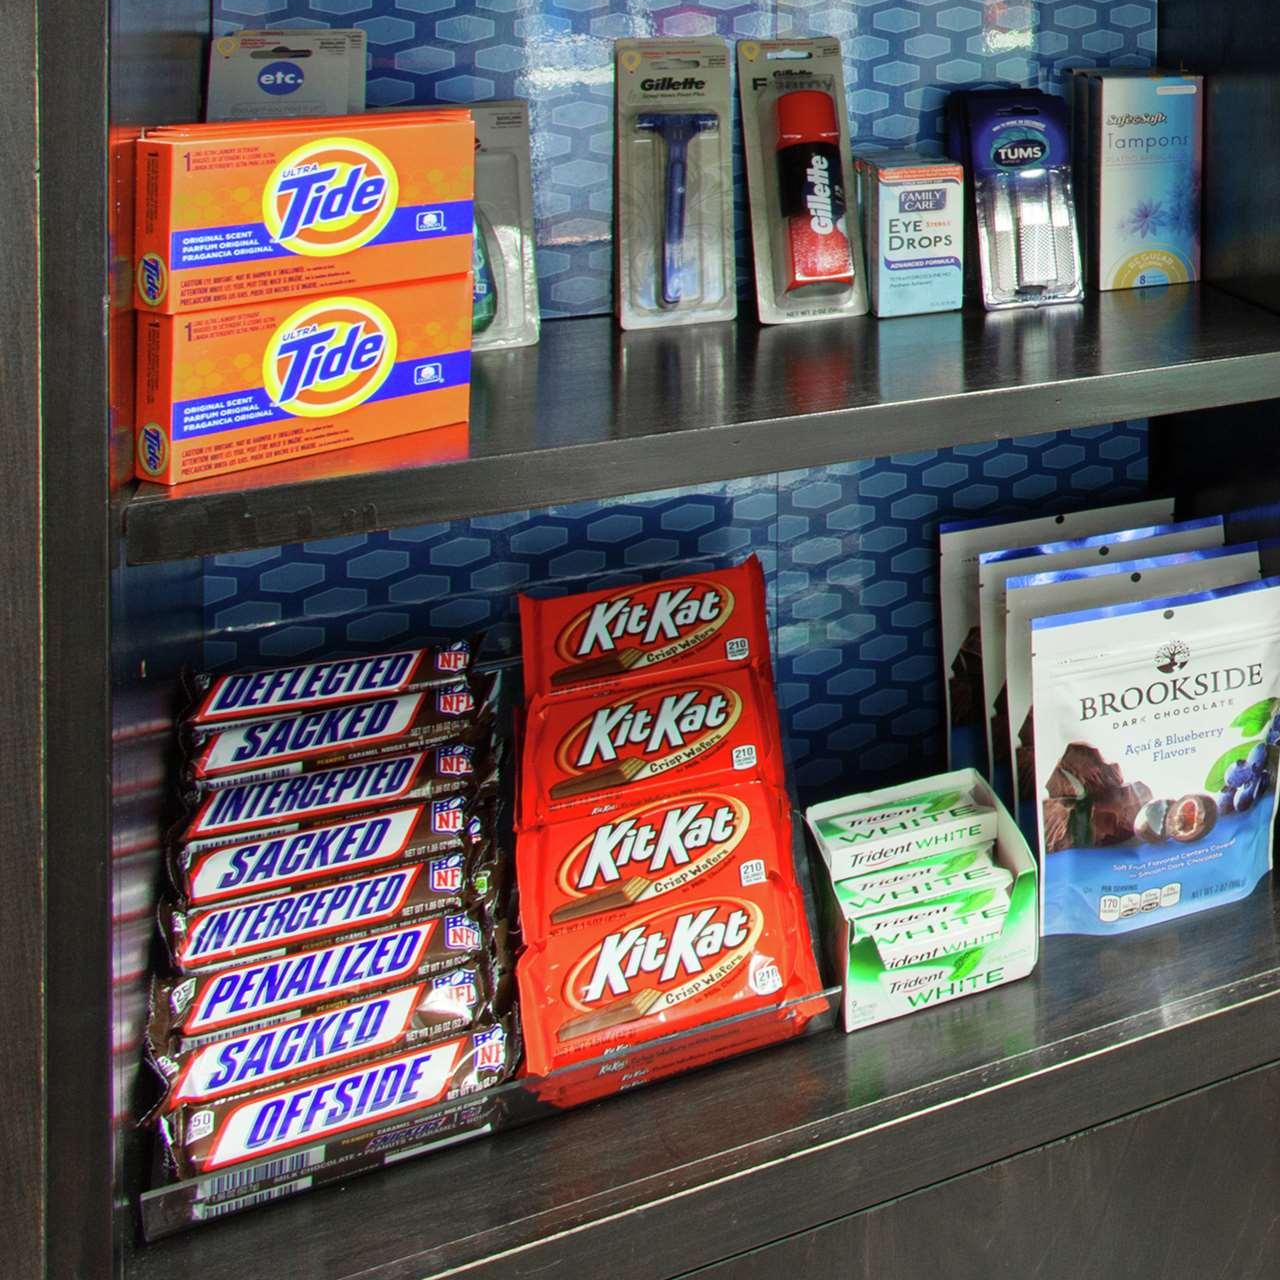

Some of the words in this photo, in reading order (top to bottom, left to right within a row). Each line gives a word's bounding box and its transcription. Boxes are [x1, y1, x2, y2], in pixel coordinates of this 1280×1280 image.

[260, 72, 304, 84] etc.
[640, 77, 705, 92] Gillette
[998, 147, 1042, 160] TUMS
[1107, 132, 1189, 153] Tampons
[282, 163, 318, 178] ULTRA
[276, 163, 389, 242] Tide
[807, 153, 833, 236] Gillette
[901, 191, 940, 202] FAMILY
[905, 200, 937, 211] CARE
[182, 234, 223, 245] ORIGINAL
[225, 231, 252, 241] SCENT
[182, 242, 217, 253] PARFUM
[219, 239, 259, 250] ORIGINAL
[182, 250, 232, 261] FRAGANCIA
[233, 246, 273, 256] ORIGINAL
[890, 261, 925, 269] ADVANCED
[925, 258, 955, 267] FORMULA
[282, 325, 317, 342] ULTRA
[276, 321, 386, 406] Tide
[184, 401, 223, 415] ORIGINAL
[226, 397, 253, 408] SCENT
[184, 410, 218, 424] PARFUM
[220, 404, 259, 417] ORIGINAL
[184, 418, 233, 432] FRAGANCIA
[234, 410, 273, 423] ORIGINAL
[646, 646, 679, 663] Crisp
[679, 627, 716, 650] Wafers
[729, 640, 746, 651] 210
[213, 653, 414, 711] DEFLECTED
[1080, 663, 1263, 721] BROOKSIDE
[441, 693, 474, 713] NFL
[1154, 698, 1235, 720] CHOCOLATE
[231, 699, 398, 762] SACKED
[1154, 737, 1163, 746] &
[1165, 727, 1224, 746] Blueberry
[649, 755, 682, 773] Crisp
[683, 733, 722, 759] Wafers
[735, 747, 753, 758] 210
[1152, 746, 1196, 762] Flavors
[206, 757, 415, 826] INTERCEPTED
[840, 804, 979, 843] WHITE
[848, 806, 918, 827] Trident
[217, 818, 392, 890] SACKED
[851, 842, 913, 868] Trident
[915, 824, 982, 849] WHITE
[654, 873, 689, 893] Crisp
[689, 849, 729, 874] Wafers
[743, 863, 762, 875] 210
[860, 867, 934, 890] Trident
[850, 867, 992, 908] WHITE
[191, 873, 408, 956] INTERCEPTED
[1103, 899, 1118, 909] 170
[875, 906, 948, 930] Trident
[200, 930, 423, 1021] PENALIZED
[665, 983, 701, 1005] Crisp
[703, 954, 744, 983] Wafers
[890, 969, 944, 994] Trident
[907, 967, 1004, 1008] WHITE
[205, 1000, 392, 1090] SACKED
[243, 1053, 433, 1150] OFFSIDE
[301, 1155, 356, 1176] CHOCOLATE
